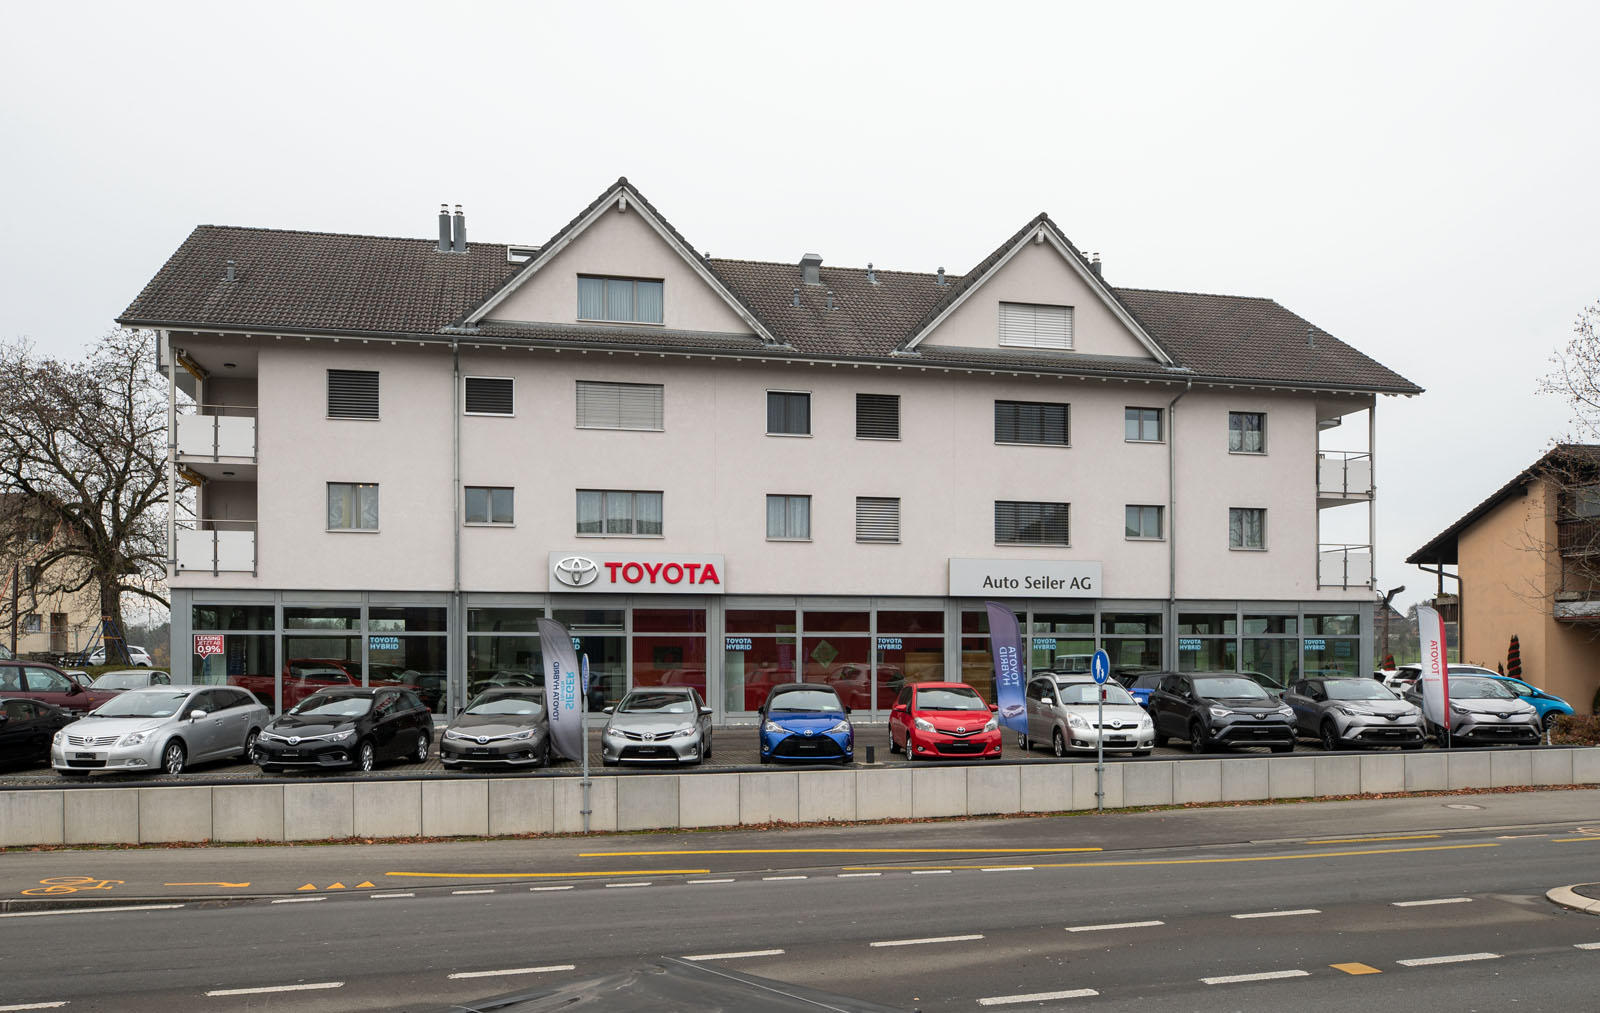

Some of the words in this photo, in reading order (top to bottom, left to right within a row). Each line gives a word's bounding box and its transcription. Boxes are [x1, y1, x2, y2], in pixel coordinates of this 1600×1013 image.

[604, 562, 720, 584] TOYOTA
[983, 575, 1020, 589] Auto
[1025, 575, 1065, 590] Seiler
[1069, 576, 1092, 591] AG
[197, 645, 221, 654] 0,9%
